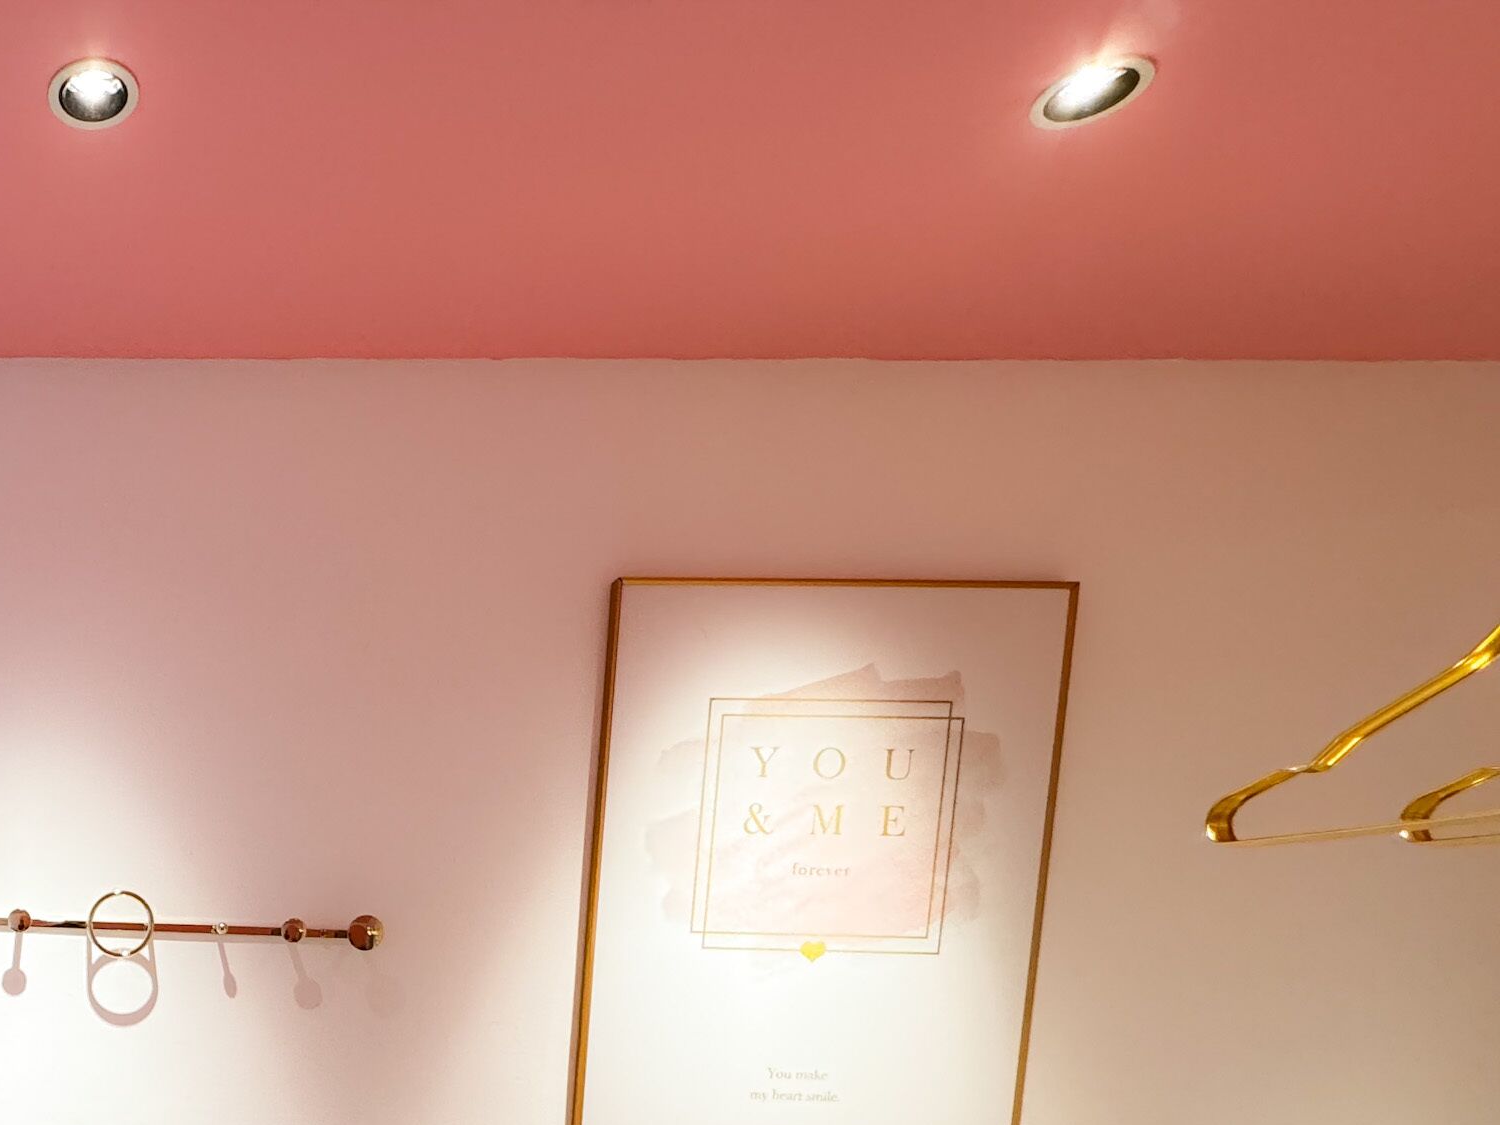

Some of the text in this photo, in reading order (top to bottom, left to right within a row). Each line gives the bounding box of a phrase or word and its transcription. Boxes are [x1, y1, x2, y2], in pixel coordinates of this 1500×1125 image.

[750, 746, 915, 781] YOU
[743, 802, 907, 837] & ME
[791, 861, 851, 877] forever
[766, 1066, 829, 1081] You make
[749, 1090, 767, 1102] my
[771, 1087, 804, 1102] heart
